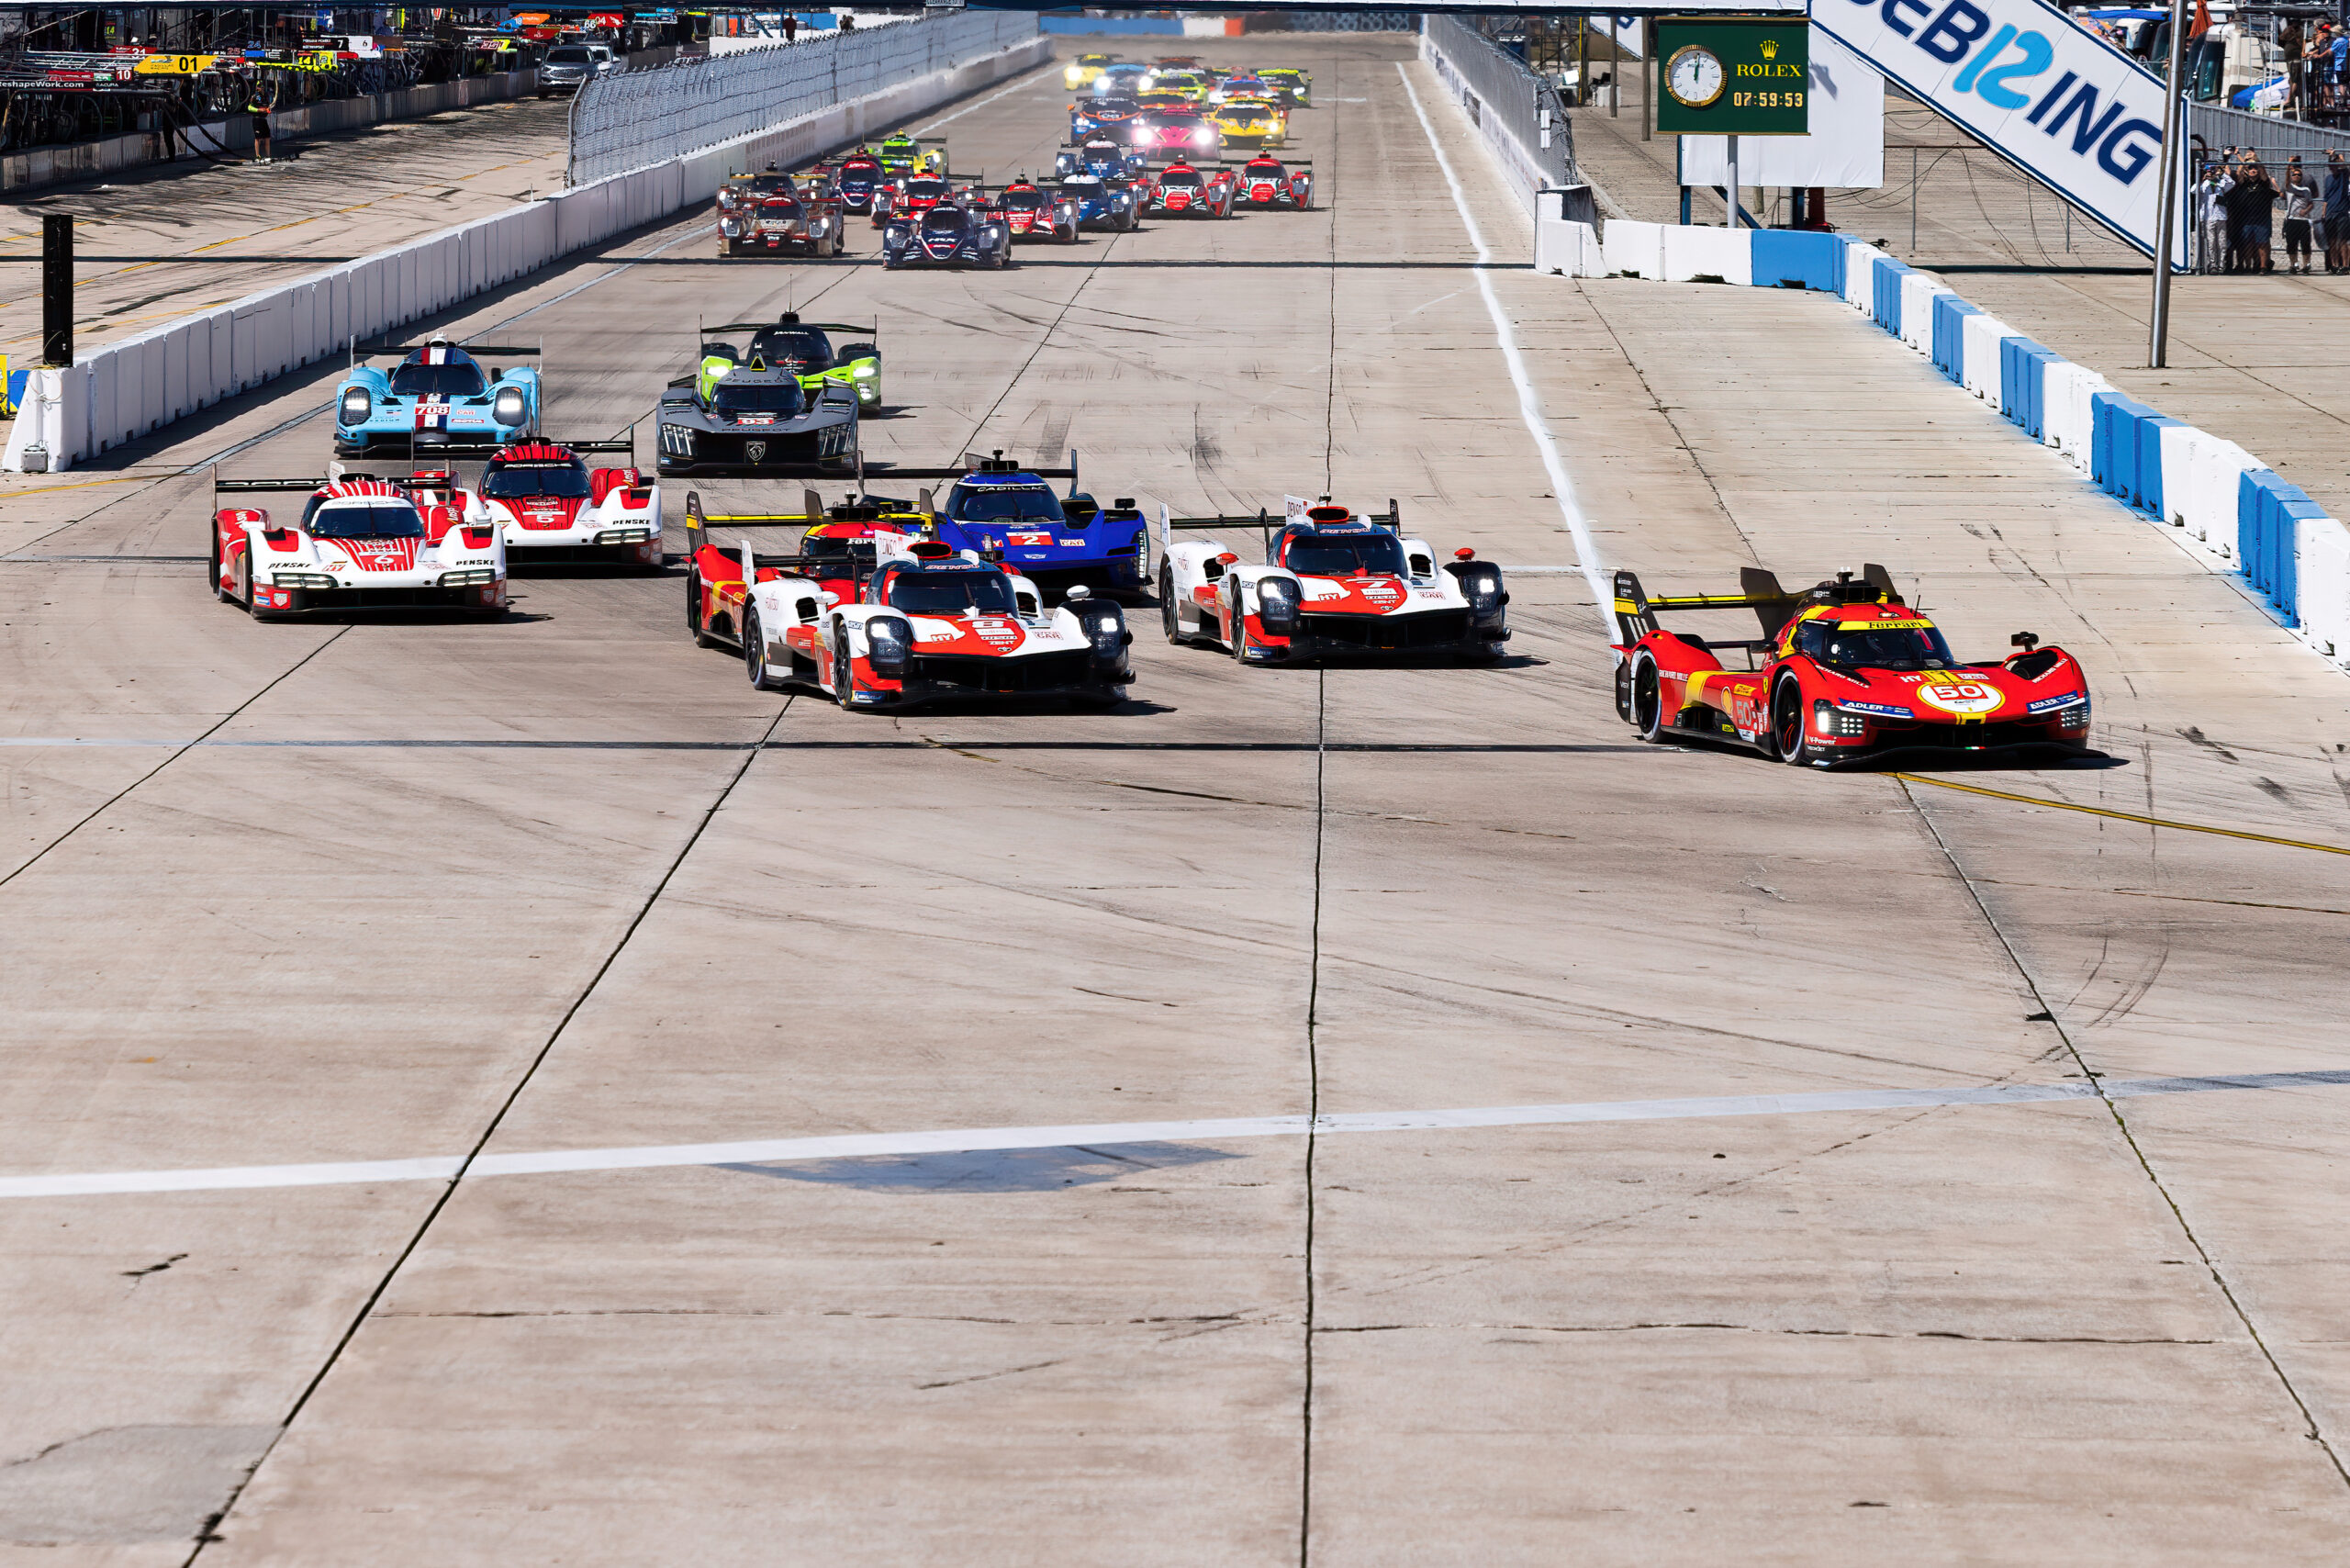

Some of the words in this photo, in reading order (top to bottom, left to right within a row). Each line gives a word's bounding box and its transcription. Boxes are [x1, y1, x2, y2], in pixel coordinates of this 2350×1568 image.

[337, 39, 344, 49] 7
[179, 56, 197, 72] 01
[117, 70, 131, 80] 10
[1737, 64, 1803, 77] ROLEX
[1846, 0, 2163, 186] EB12ING
[1733, 92, 1803, 107] 07:59:53
[417, 407, 449, 415] 708
[535, 514, 554, 523] 5
[1021, 535, 1042, 545] 2
[374, 554, 395, 564] 6
[268, 561, 312, 570] PENSKE
[1869, 621, 1924, 629] Ferrari
[1814, 664, 1846, 679] RICHARD
[1846, 678, 1870, 689] MILLE
[1899, 675, 1922, 683] HY
[1933, 685, 1983, 698] 50
[1845, 701, 1885, 711] ADLER
[2029, 698, 2060, 710] ADLER
[1736, 700, 1751, 727] 50
[1809, 736, 1836, 745] V-Power
